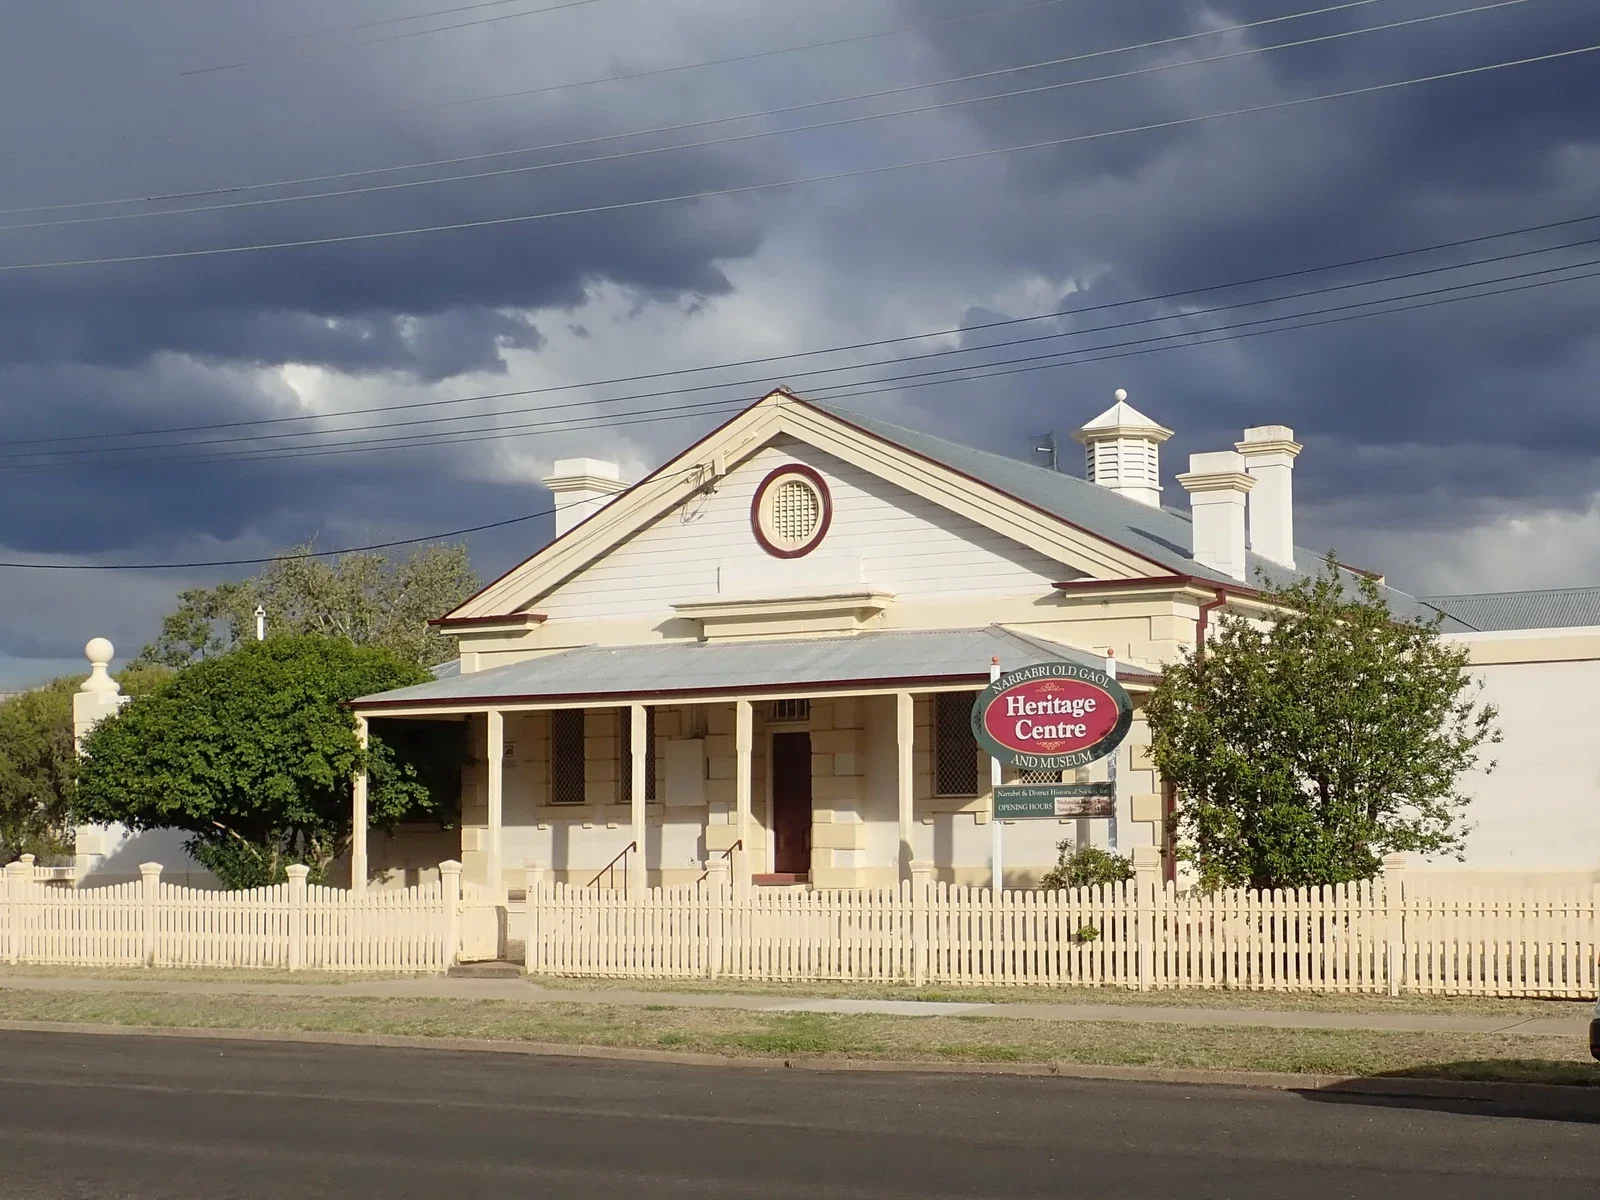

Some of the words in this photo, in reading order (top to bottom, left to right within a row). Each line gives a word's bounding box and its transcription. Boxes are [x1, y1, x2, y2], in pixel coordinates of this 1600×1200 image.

[991, 666, 1051, 694] NARRABRI
[1052, 665, 1077, 676] OLD
[1079, 669, 1110, 688] GAOL
[1005, 694, 1096, 718] Heritage
[1014, 719, 1087, 740] Centre
[1010, 753, 1038, 768] AND
[1040, 750, 1093, 769] MUSEUM
[997, 789, 1021, 797] Narrabri
[998, 803, 1028, 811] OPENING
[1029, 802, 1053, 810] HOURS
